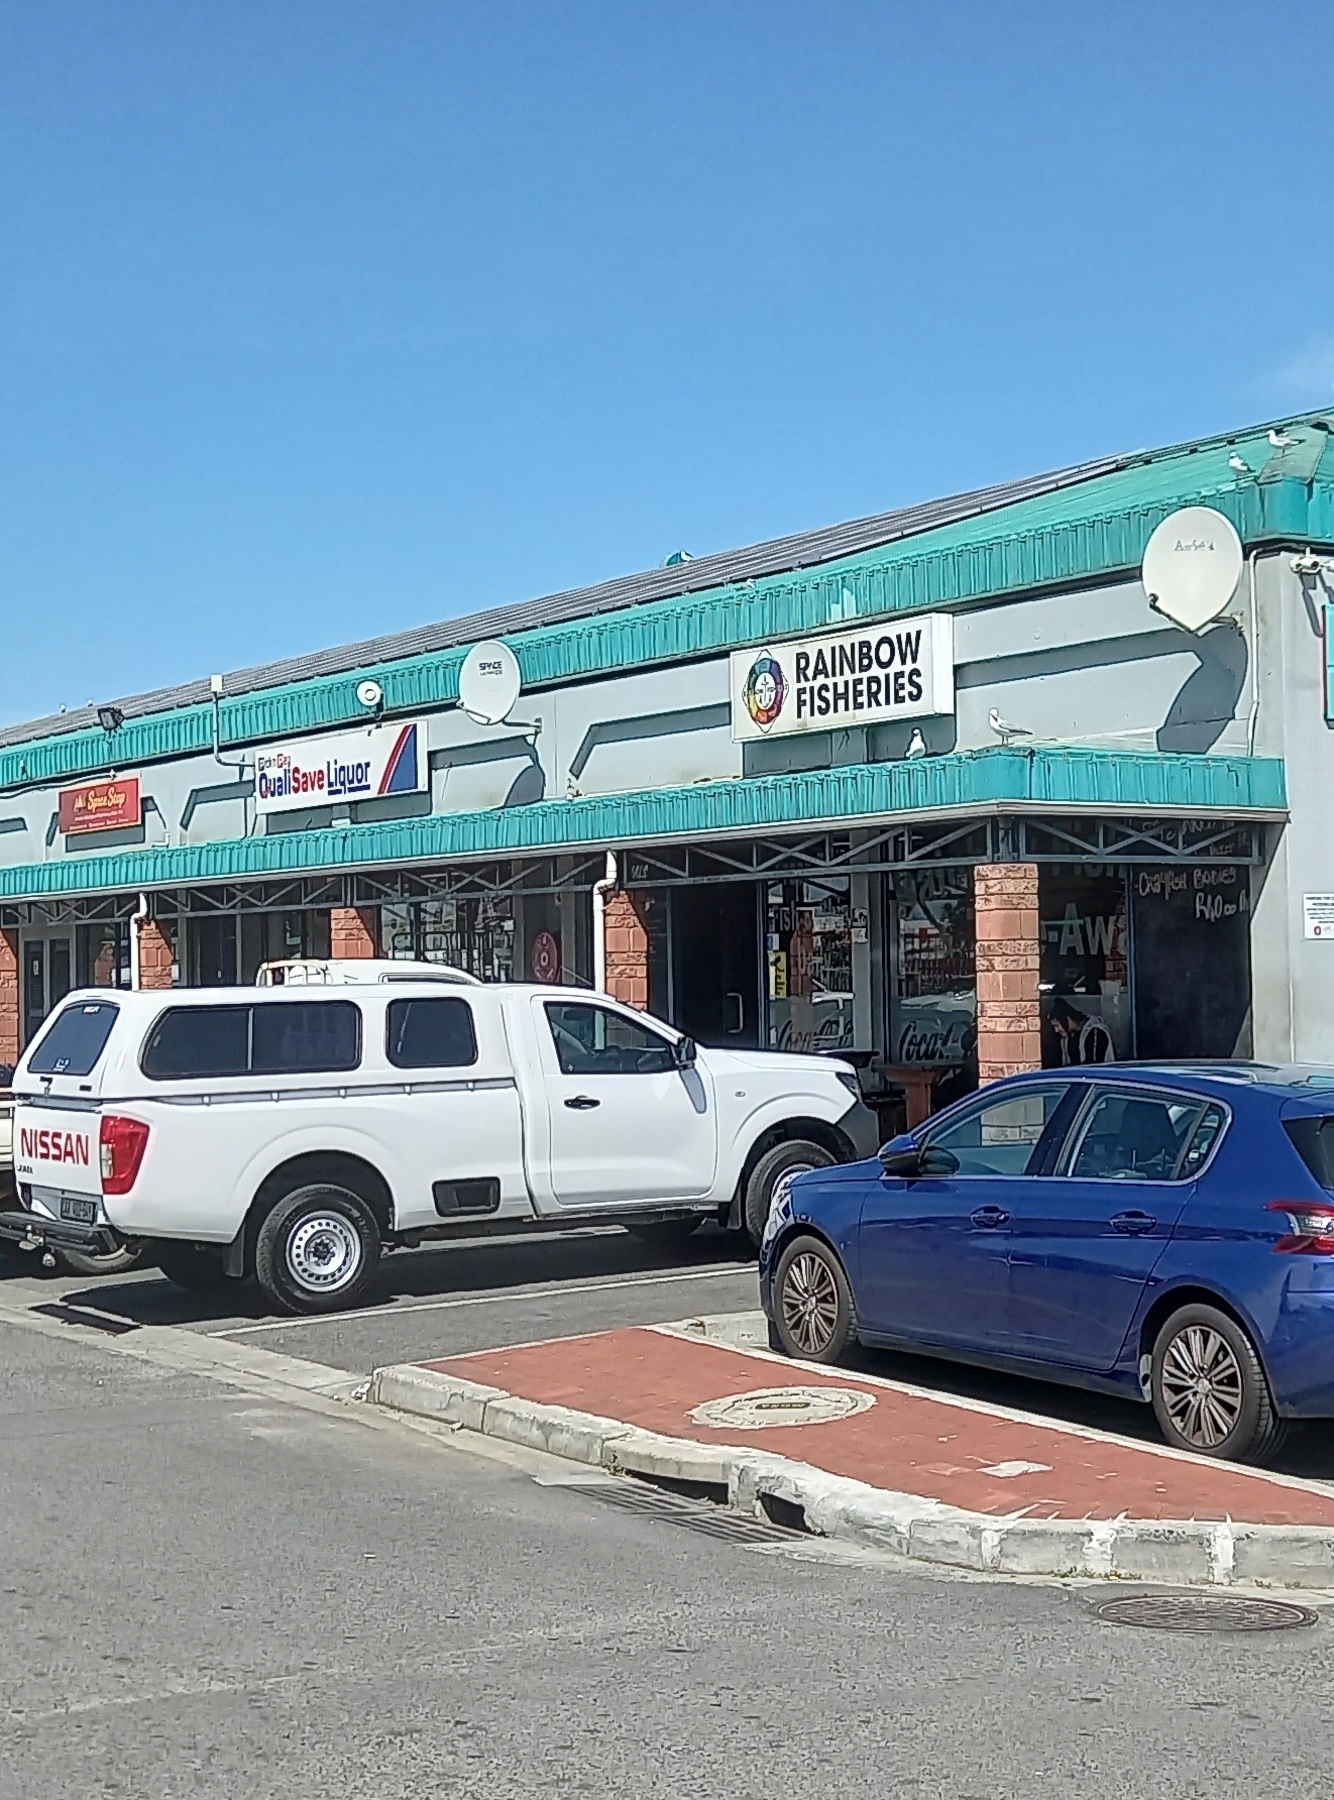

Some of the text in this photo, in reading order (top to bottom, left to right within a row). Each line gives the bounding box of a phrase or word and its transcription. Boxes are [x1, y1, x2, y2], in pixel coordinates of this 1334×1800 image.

[796, 629, 922, 683] RAINBOW
[796, 668, 923, 719] FISHERIES
[259, 759, 370, 799] QualiSave Liquor
[21, 1127, 89, 1166] NISSAN
